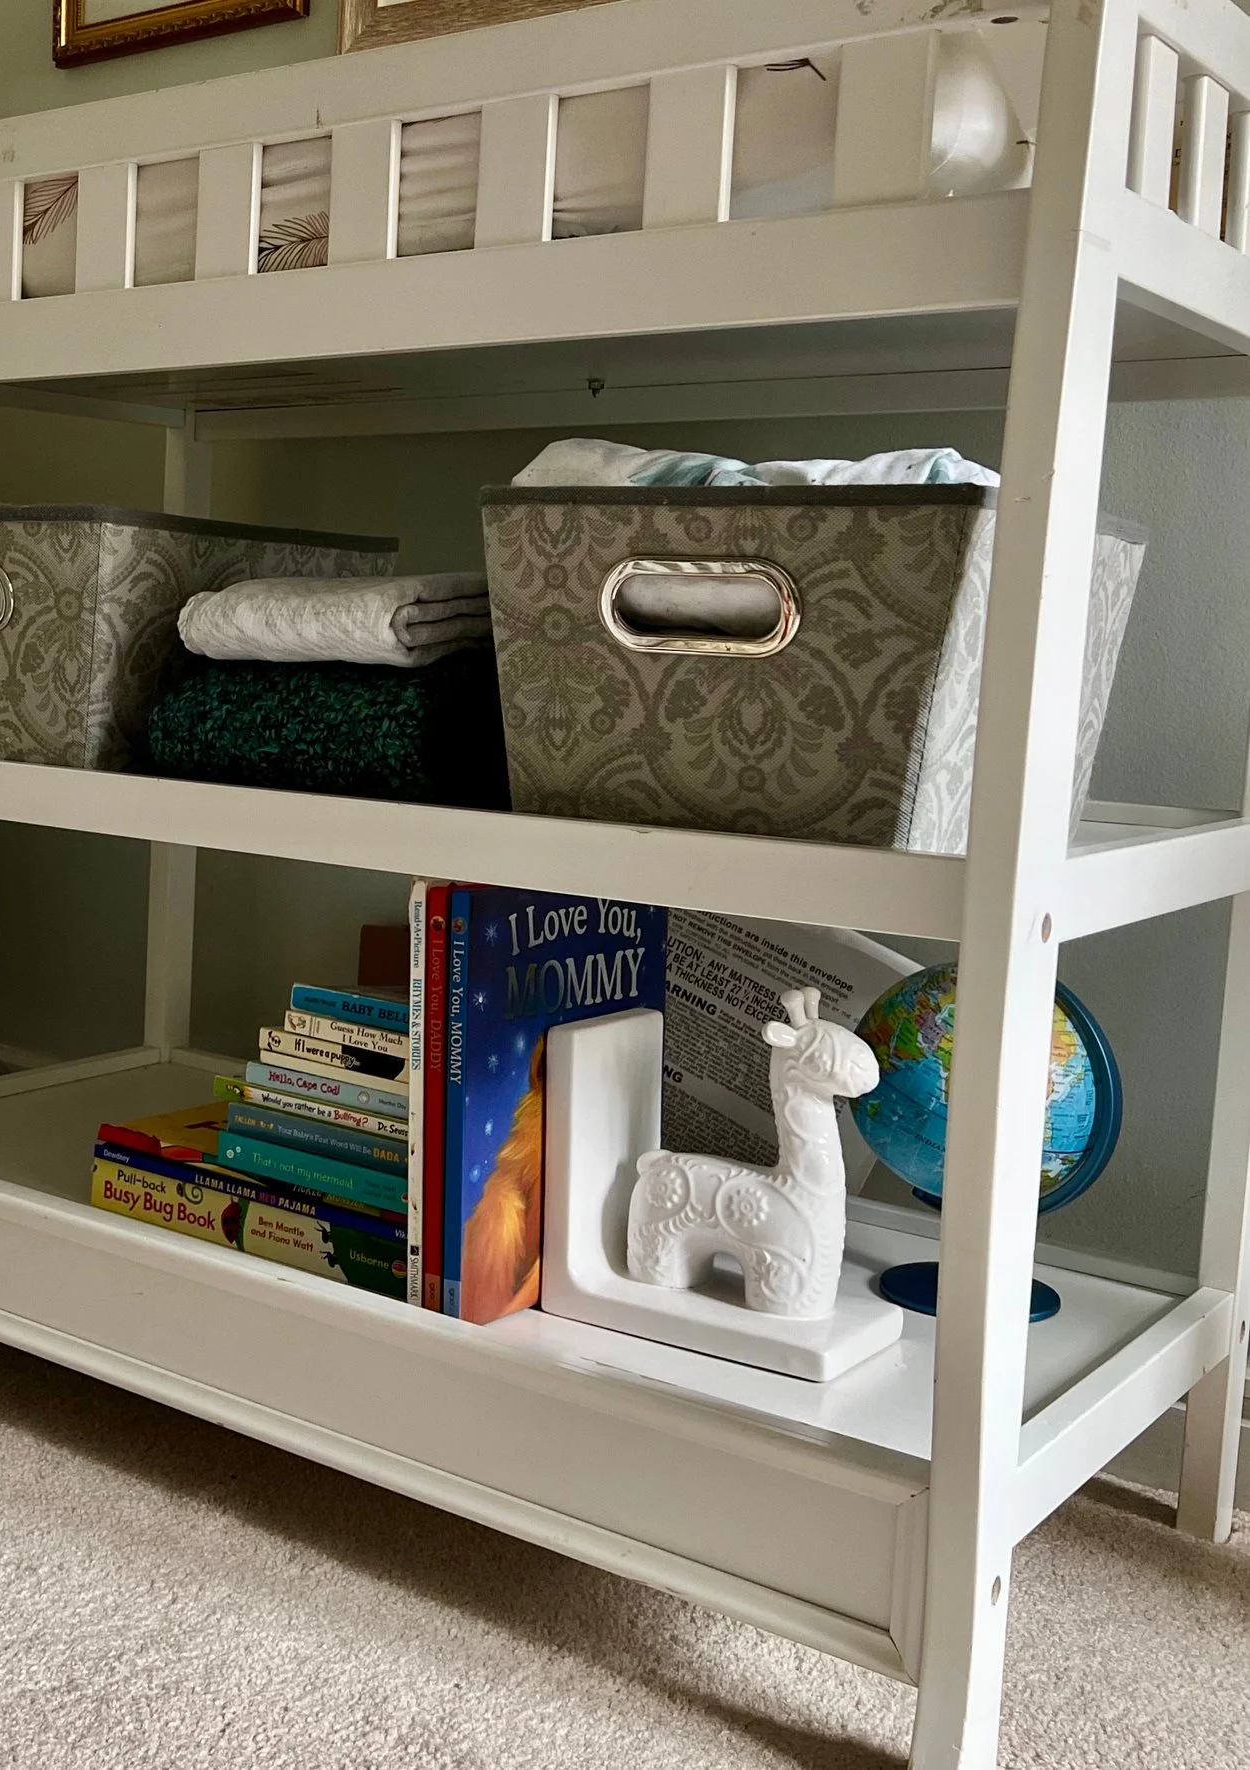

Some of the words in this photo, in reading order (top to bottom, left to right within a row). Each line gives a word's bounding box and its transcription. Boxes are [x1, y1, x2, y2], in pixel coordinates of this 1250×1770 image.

[508, 912, 521, 957] I
[526, 905, 588, 949] Love
[597, 898, 642, 945] You,
[673, 913, 687, 924] NOT
[688, 921, 716, 938] REMOVE
[732, 943, 767, 965] ENVELOPE
[431, 945, 444, 981] Love
[452, 949, 465, 983] Love
[745, 931, 759, 942] are
[761, 938, 788, 957] inside
[791, 953, 808, 968] this
[809, 966, 855, 993] envelope.
[505, 947, 646, 1020] MOMMY
[672, 953, 687, 966] BE
[686, 961, 701, 973] AT
[700, 967, 731, 989] LEAST
[730, 983, 743, 995] 27
[750, 995, 784, 1019] INCHES
[674, 966, 725, 999] THICKNESS
[725, 993, 745, 1010] NOT
[707, 959, 729, 975] ANY
[727, 969, 777, 1002] MATTRESS
[341, 1001, 374, 1017] BABY
[412, 977, 423, 1020] RHYMES
[451, 987, 465, 1018] You,
[330, 1021, 355, 1035] Guess
[356, 1027, 377, 1041] How
[379, 1032, 404, 1046] Much
[411, 1020, 422, 1029] &
[305, 1046, 324, 1056] were
[325, 1049, 330, 1058] a
[341, 1033, 347, 1043] I
[349, 1035, 369, 1049] Love
[372, 1041, 389, 1053] You
[411, 1029, 422, 1071] STORIES
[430, 1019, 443, 1073] DADDY
[450, 1021, 465, 1085] MOMMY
[268, 1070, 295, 1087] Hello,
[296, 1077, 318, 1092] Cape
[320, 1083, 342, 1096] Cod!
[261, 1092, 281, 1106] Would
[282, 1099, 294, 1109] you
[294, 1102, 316, 1114] rather
[317, 1107, 326, 1116] be
[333, 1109, 369, 1128] Bullfrog?
[377, 1121, 388, 1132] Dr.
[388, 1124, 408, 1137] Seuss
[103, 1148, 130, 1164] Dewdney
[252, 1152, 277, 1169] That's
[279, 1162, 295, 1173] not
[297, 1167, 311, 1181] my
[329, 1138, 348, 1150] Word
[363, 1146, 373, 1155] Be
[373, 1147, 400, 1163] DADA
[117, 1169, 167, 1194] Pull-back
[194, 1173, 225, 1192] LLAMA
[226, 1183, 257, 1200] LLAMA
[278, 1196, 317, 1216] PAJAMA
[104, 1180, 141, 1211] Busy
[143, 1191, 174, 1222] Bug
[177, 1202, 217, 1231] Book
[251, 1226, 266, 1239] and
[268, 1230, 291, 1246] Fiona
[292, 1237, 314, 1252] Watt
[258, 1215, 274, 1229] Ben
[275, 1220, 305, 1238] Mantle
[394, 1228, 408, 1240] Vik
[349, 1248, 391, 1270] Usborne
